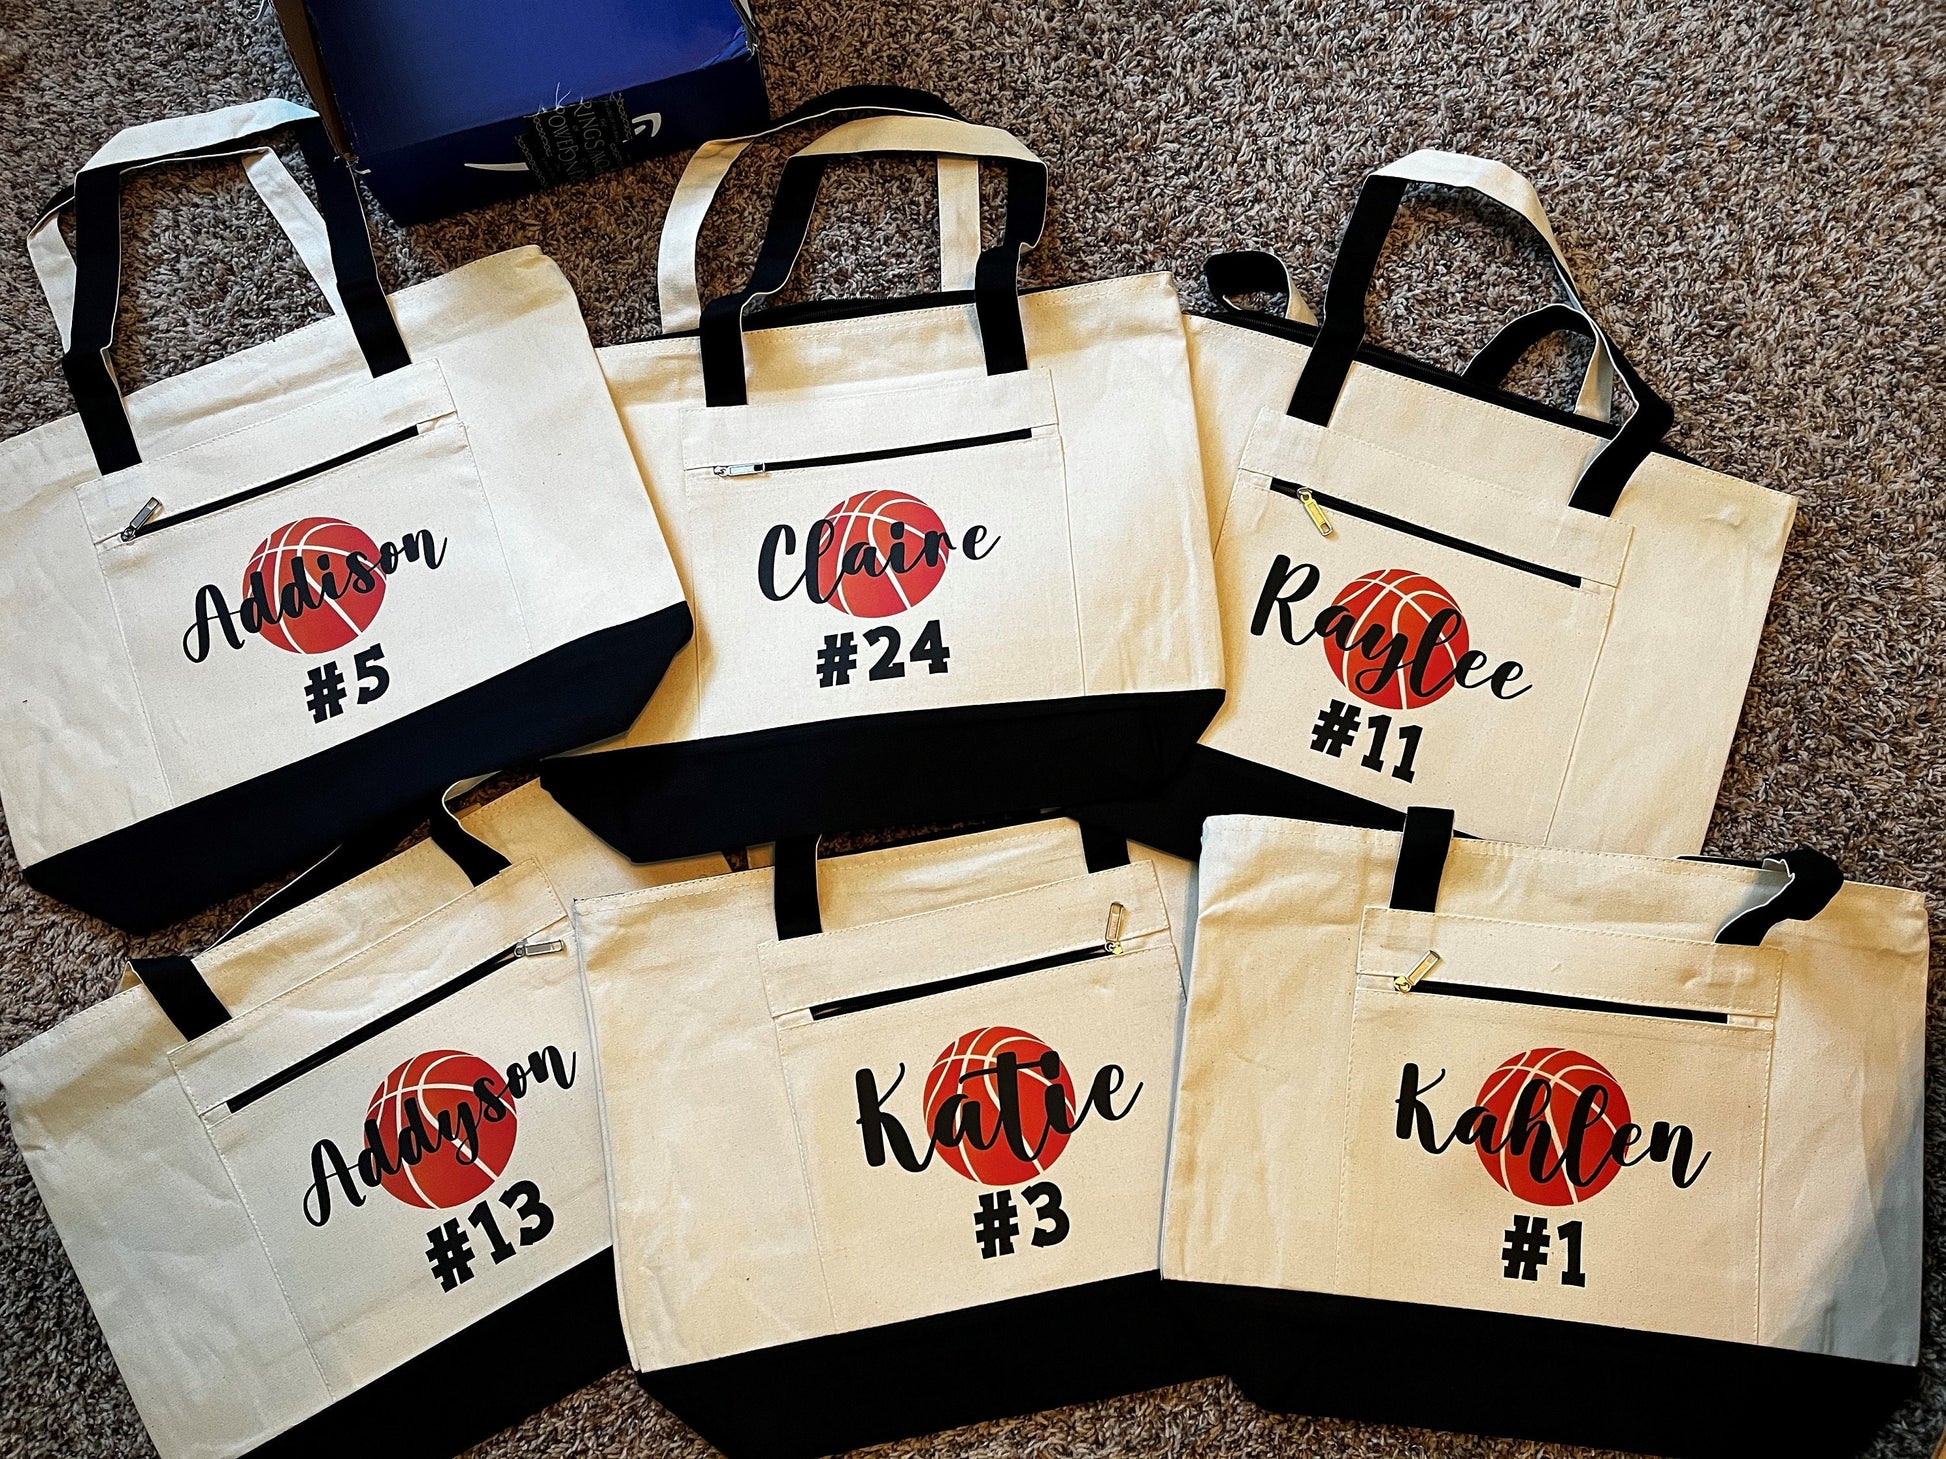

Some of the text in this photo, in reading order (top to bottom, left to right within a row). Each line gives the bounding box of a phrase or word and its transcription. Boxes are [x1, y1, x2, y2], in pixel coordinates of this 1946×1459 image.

[573, 100, 606, 151] RINGS
[182, 528, 447, 664] Addison
[758, 519, 1000, 603] Claire
[816, 620, 951, 688] #24
[1250, 554, 1533, 699] Raylee
[303, 642, 390, 724] #5
[1310, 698, 1424, 784] #11
[303, 1045, 577, 1227] Addyson
[855, 1050, 1144, 1173] Katie
[1395, 1062, 1712, 1189] Kahlen
[424, 1180, 555, 1293] #13
[973, 1181, 1070, 1260] #3
[1501, 1214, 1586, 1288] #1
